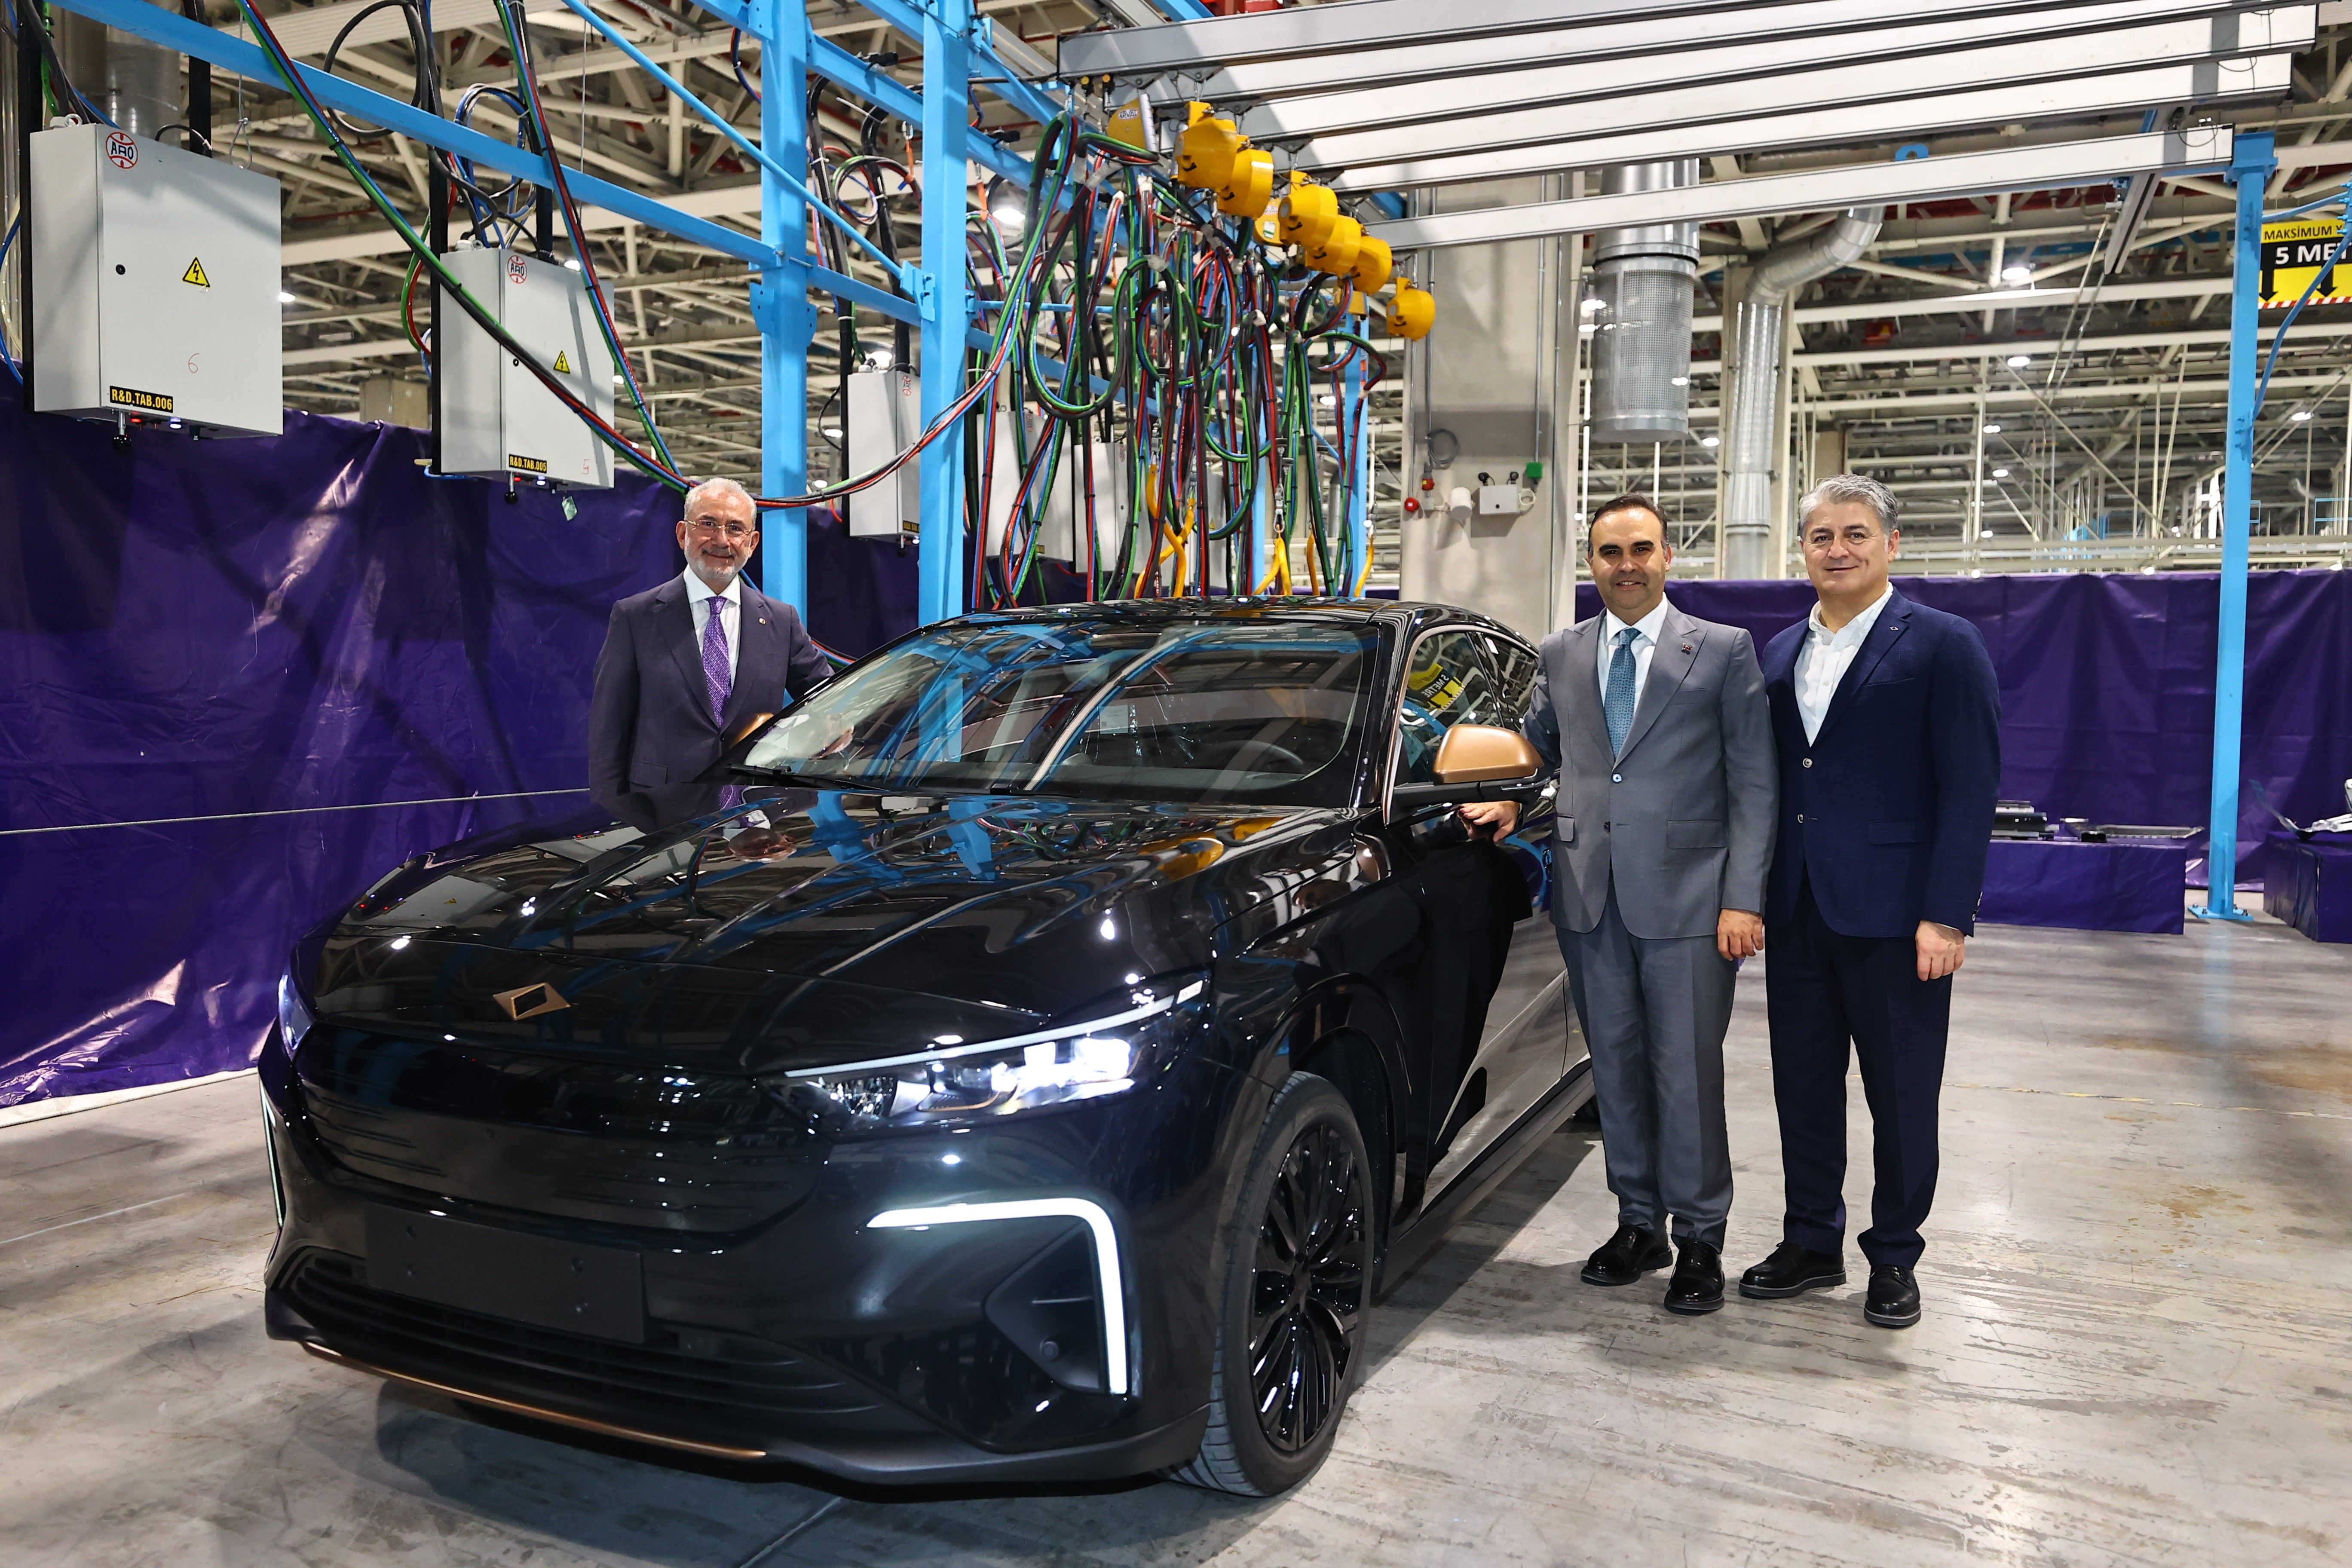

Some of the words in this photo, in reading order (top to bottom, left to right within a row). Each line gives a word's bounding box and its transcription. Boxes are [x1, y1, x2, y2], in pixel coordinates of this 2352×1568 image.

[111, 141, 134, 159] ARO
[2264, 226, 2332, 240] MAKSİMUM
[2275, 246, 2289, 265] 5
[511, 263, 524, 276] ARO
[188, 353, 199, 373] 6
[112, 389, 172, 410] R&D.TAB.006
[510, 456, 546, 472] R&D.TAB.005
[581, 459, 590, 474] 5
